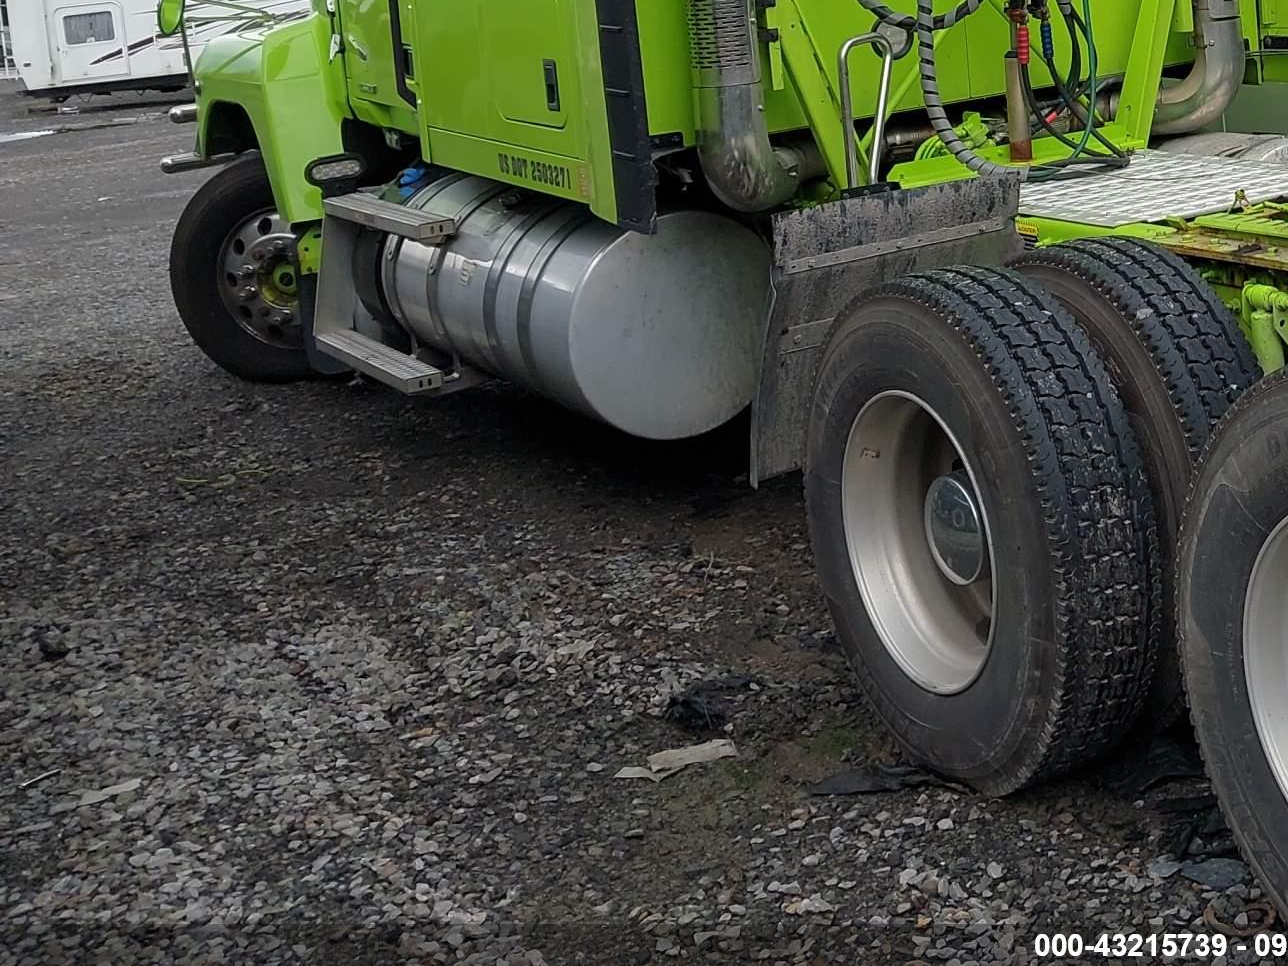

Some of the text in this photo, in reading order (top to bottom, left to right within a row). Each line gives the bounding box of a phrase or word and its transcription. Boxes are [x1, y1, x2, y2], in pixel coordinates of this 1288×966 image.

[497, 153, 571, 190] US DOT 2503271
